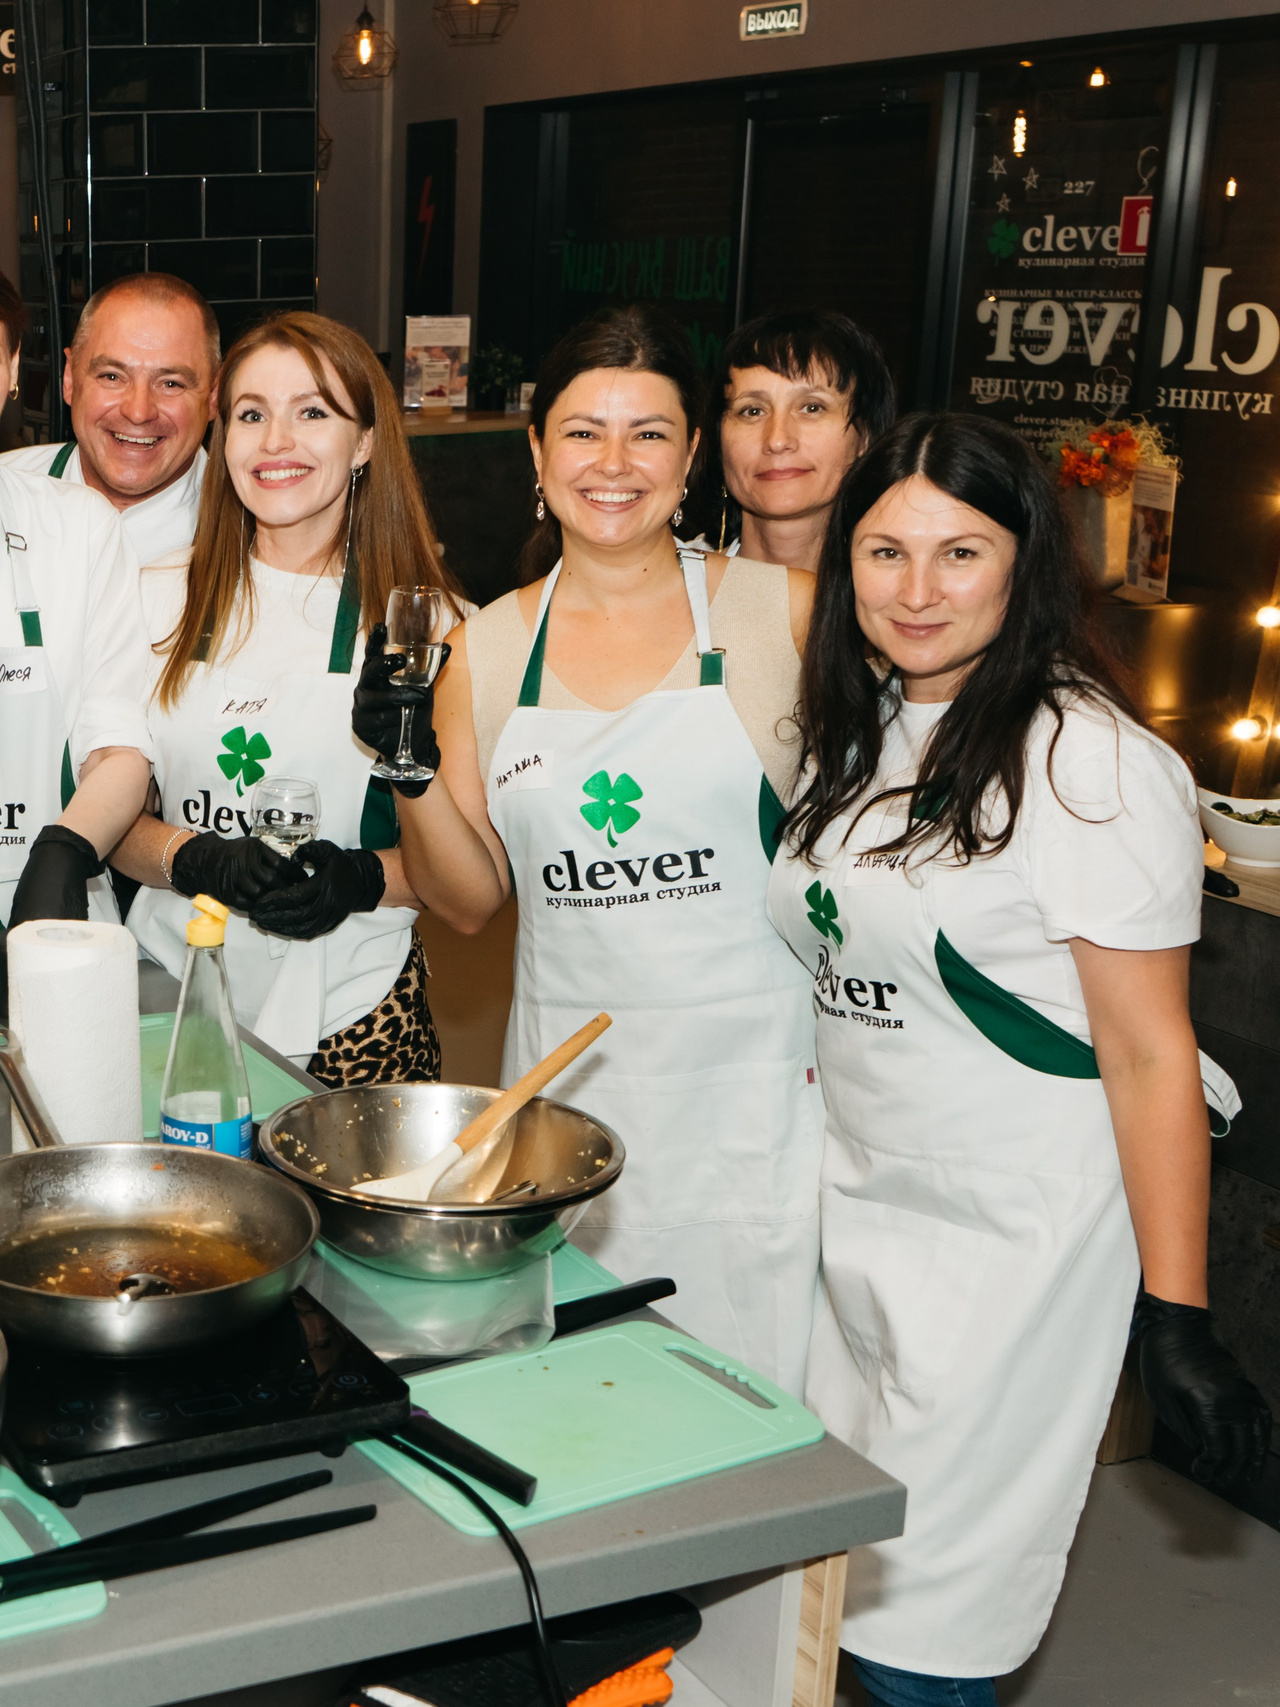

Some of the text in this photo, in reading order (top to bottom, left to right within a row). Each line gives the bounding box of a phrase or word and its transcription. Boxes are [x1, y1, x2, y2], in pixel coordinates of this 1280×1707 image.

[747, 8, 799, 32] ВЫХОД
[1063, 180, 1096, 197] 227
[1021, 214, 1121, 253] cleve
[1018, 257, 1145, 269] кулинарная студия
[222, 698, 268, 714] КАТЯ
[496, 754, 543, 789] НАТАША
[182, 789, 315, 838] clever
[542, 847, 715, 893] clever
[546, 881, 722, 909] кулинарная студия
[851, 1011, 904, 1029] студия
